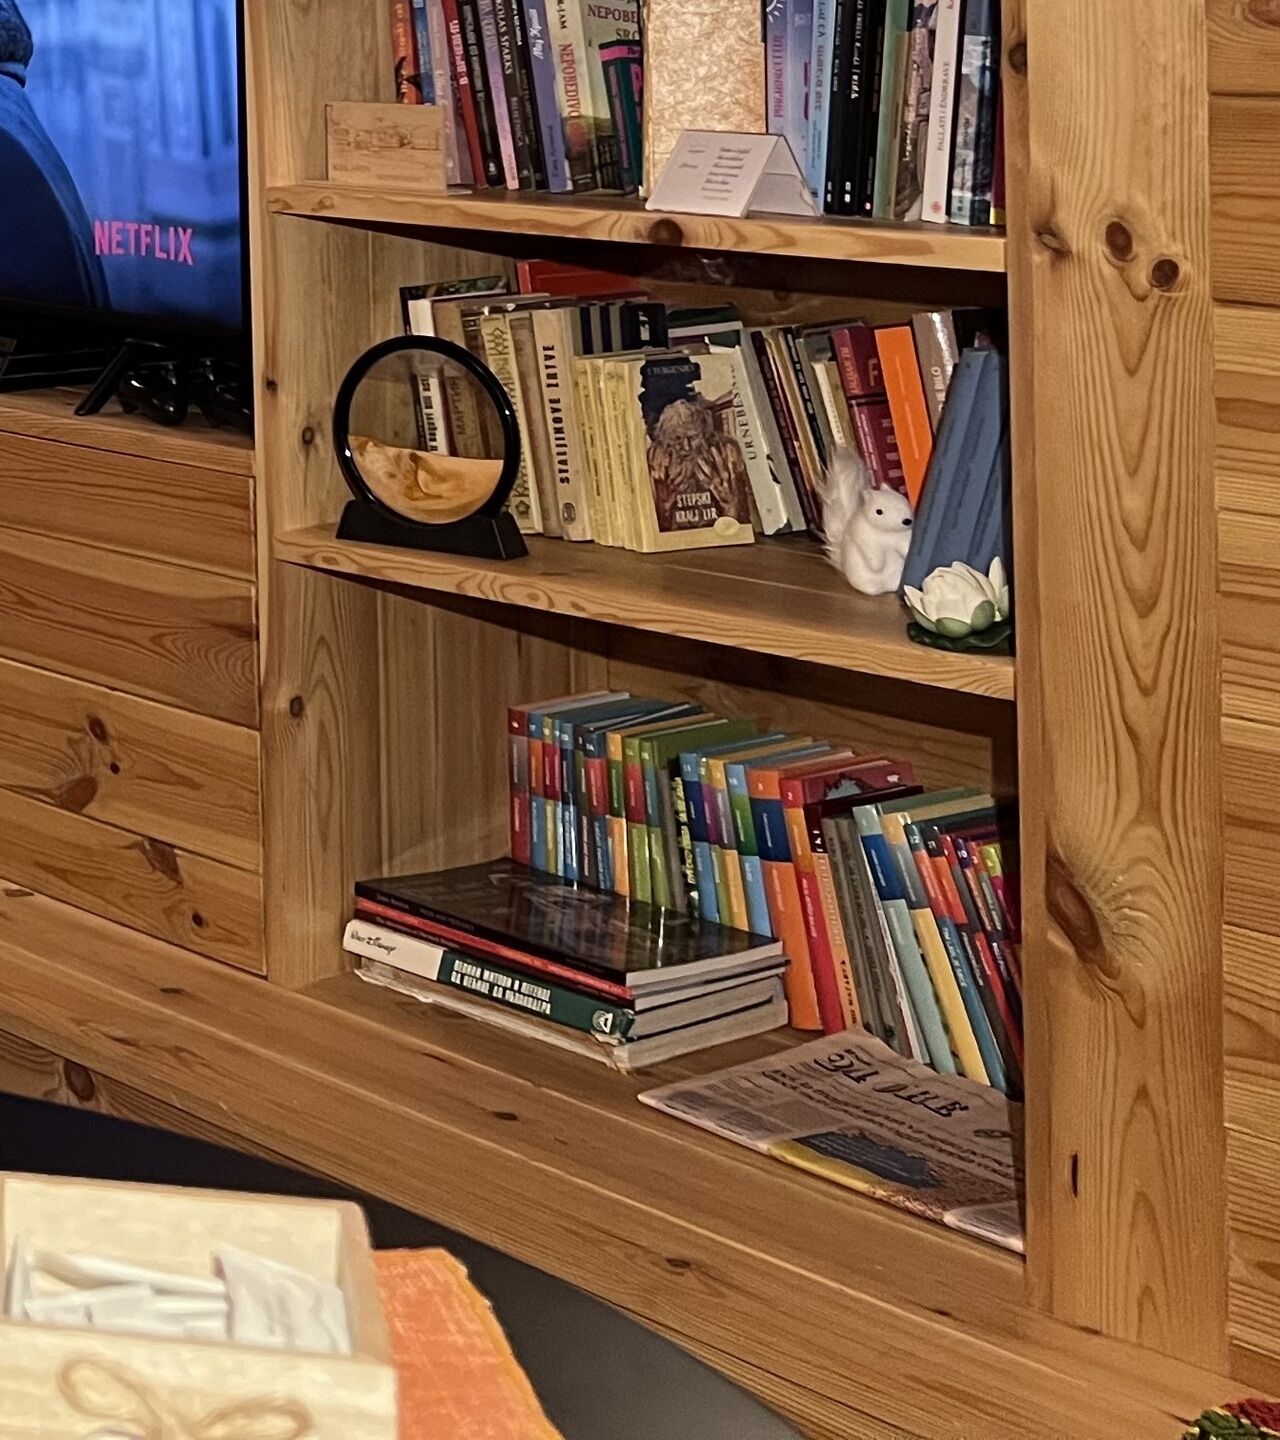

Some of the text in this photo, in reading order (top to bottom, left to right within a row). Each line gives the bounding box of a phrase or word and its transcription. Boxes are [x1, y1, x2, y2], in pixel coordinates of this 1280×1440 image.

[587, 4, 638, 24] NEPOBE
[499, 35, 513, 75] SPARKS
[558, 43, 579, 120] NEPOBEDIVO
[93, 219, 195, 267] NETFLIX
[548, 395, 571, 485] STALJINOVE
[676, 492, 712, 508] STEPSKI
